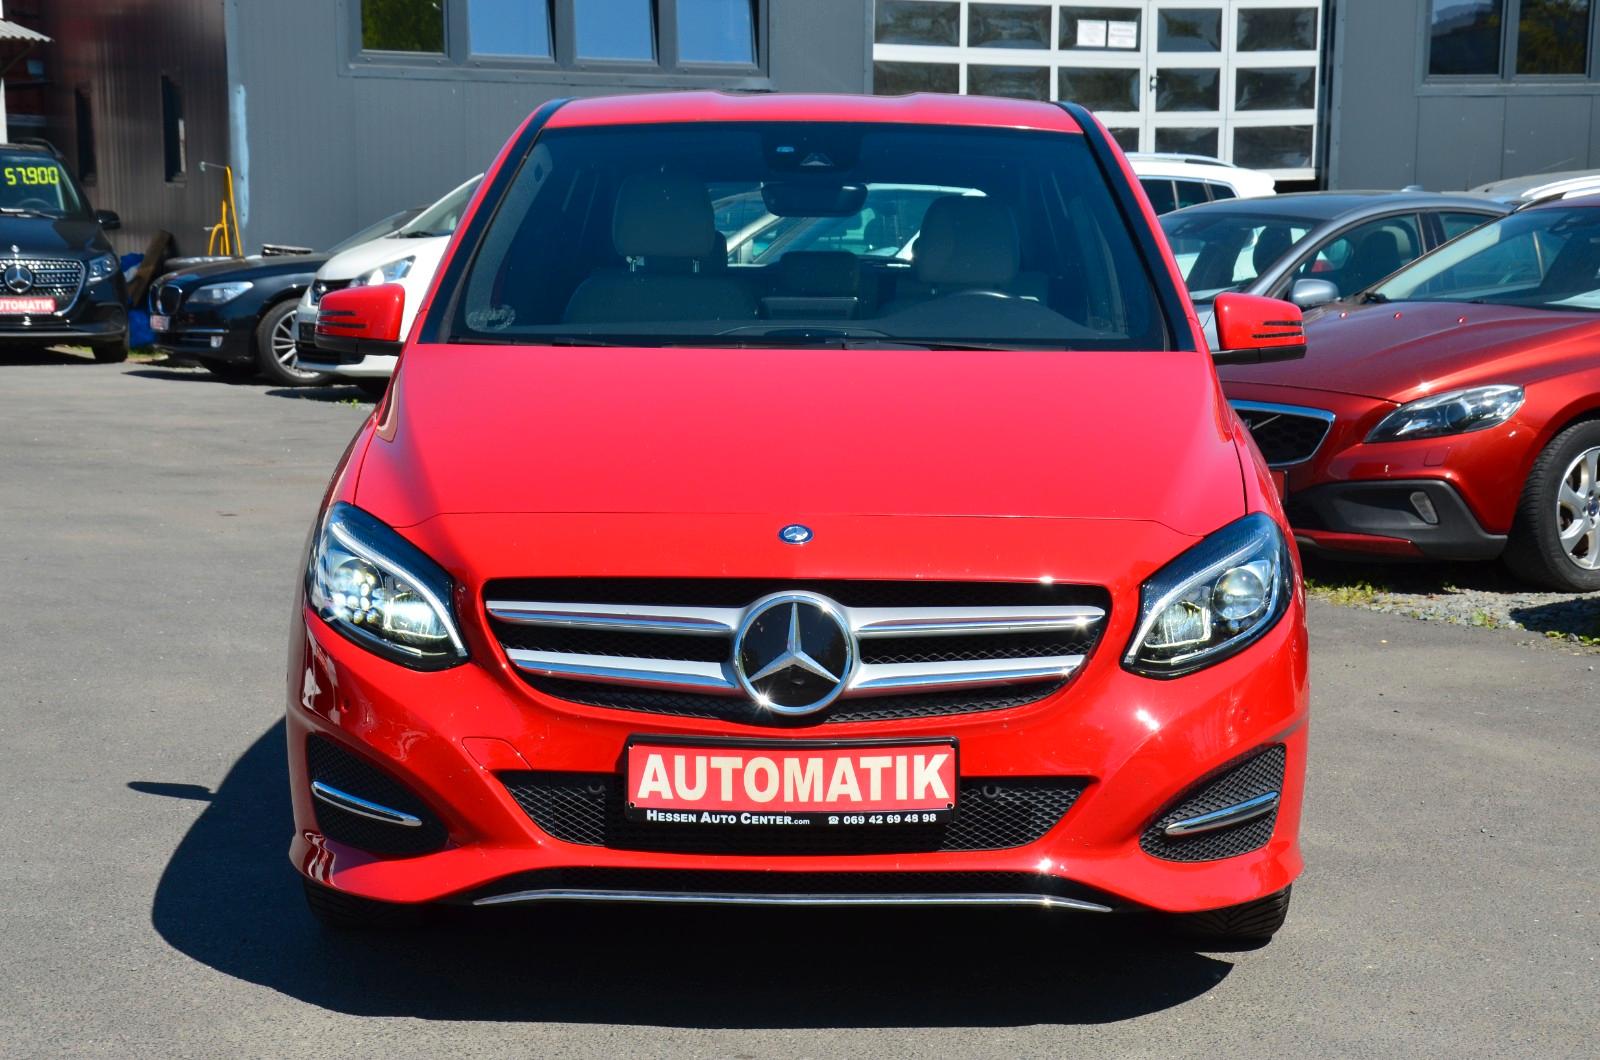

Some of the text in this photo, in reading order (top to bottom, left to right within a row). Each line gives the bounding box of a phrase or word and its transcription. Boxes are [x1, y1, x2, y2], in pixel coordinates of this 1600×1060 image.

[637, 753, 950, 803] AUTOMATIK
[646, 809, 697, 823] HESSEN
[700, 811, 737, 824] AUTO
[843, 813, 937, 825] 069 42 69 48 98
